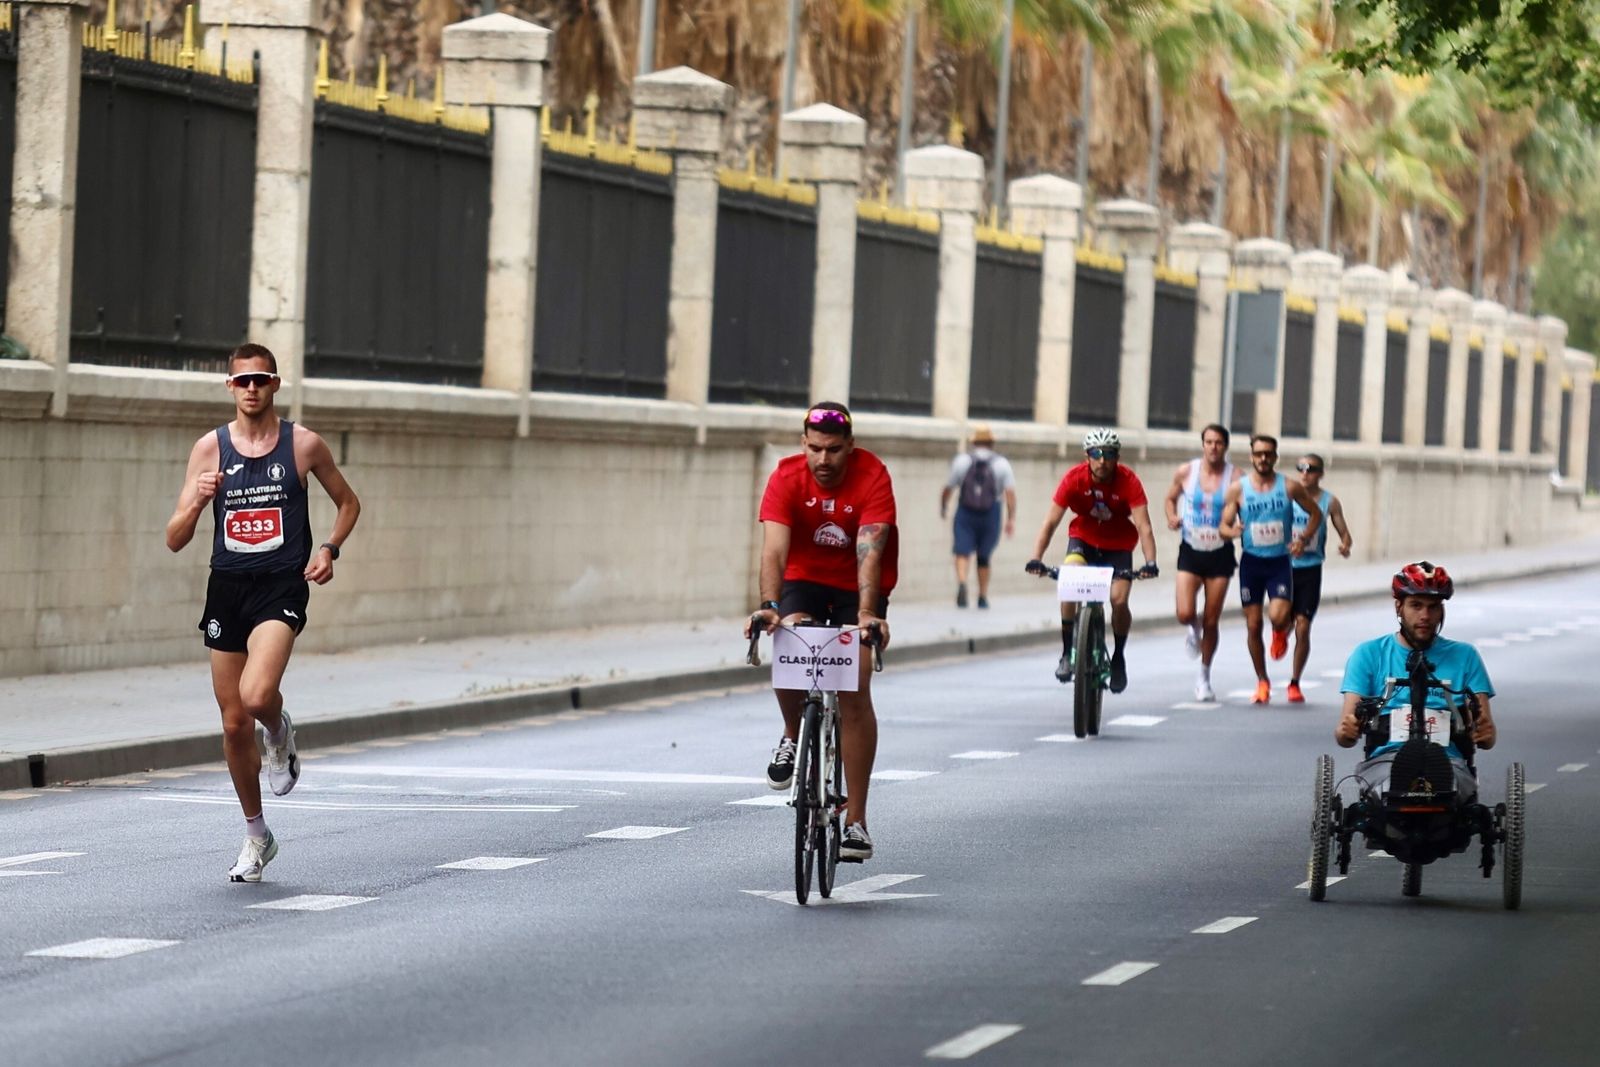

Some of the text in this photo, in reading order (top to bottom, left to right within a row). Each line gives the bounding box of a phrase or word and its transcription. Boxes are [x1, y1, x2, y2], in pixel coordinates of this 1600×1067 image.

[226, 485, 283, 498] CLUB ATLETISMO
[231, 519, 275, 533] 2333
[779, 655, 853, 666] CLASIFICADO
[806, 668, 825, 677] 5 K
